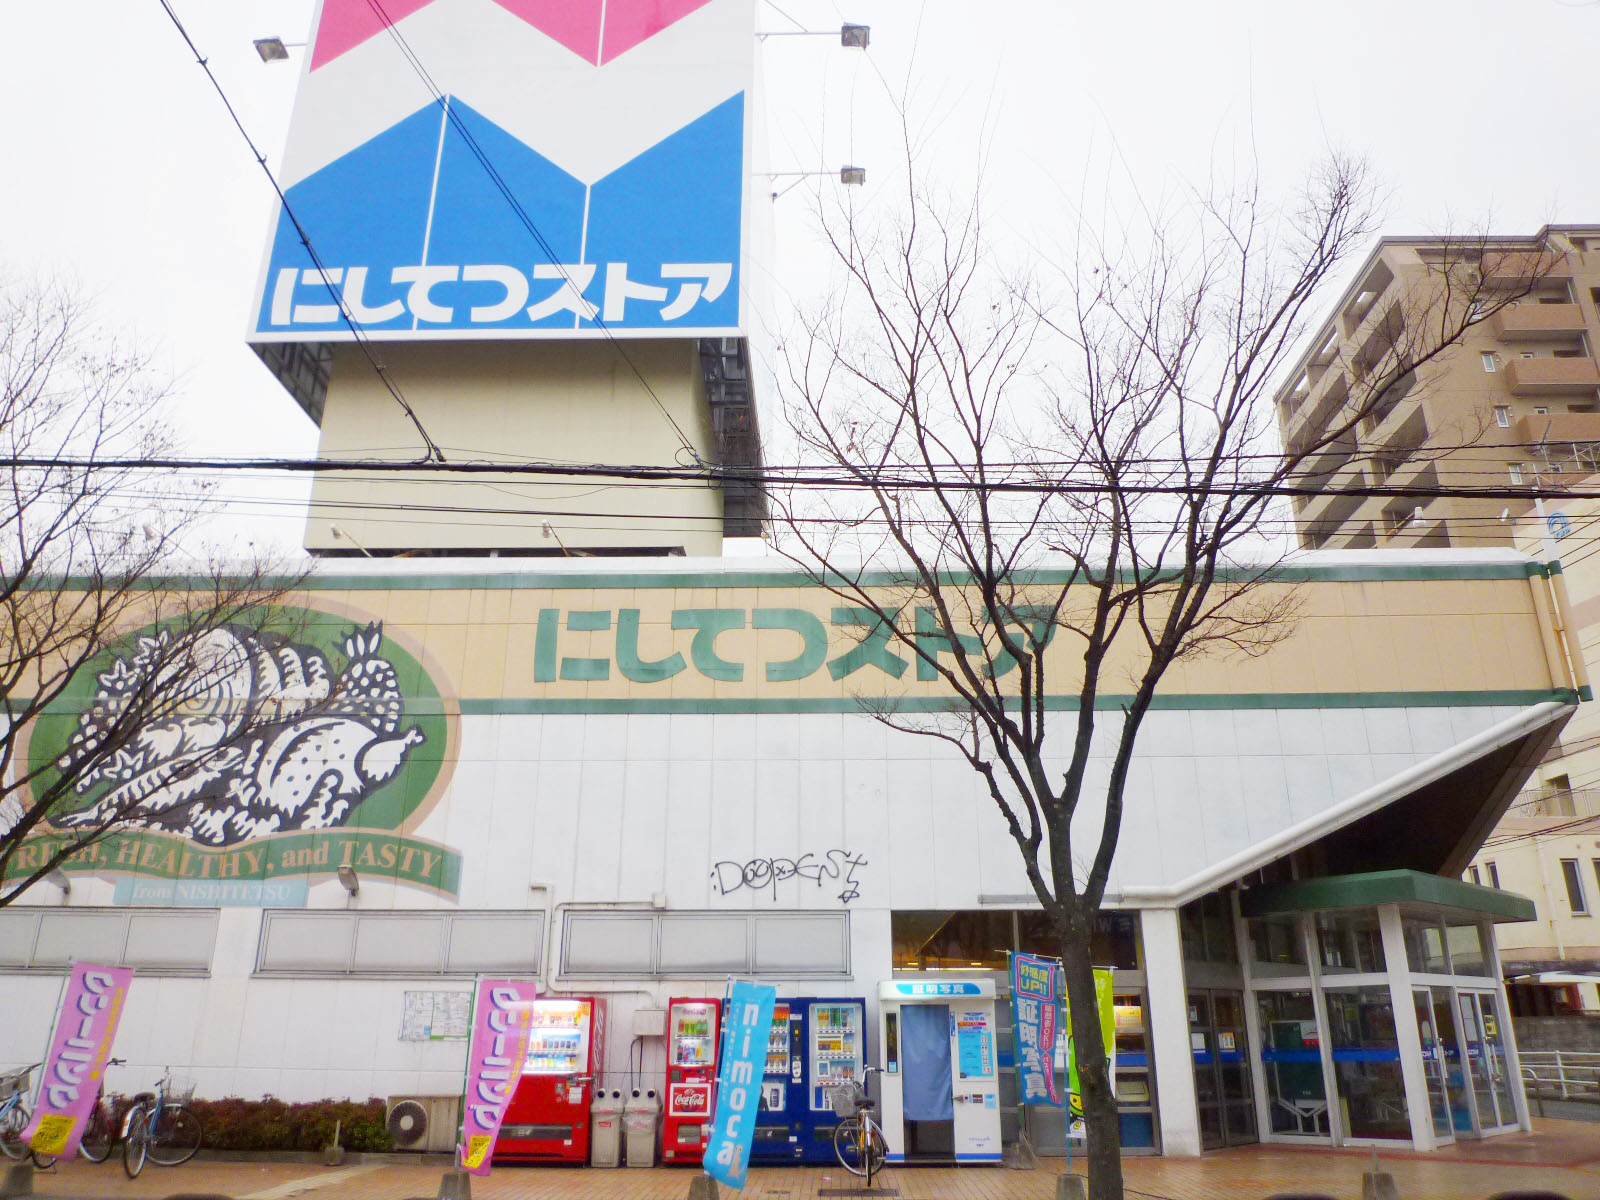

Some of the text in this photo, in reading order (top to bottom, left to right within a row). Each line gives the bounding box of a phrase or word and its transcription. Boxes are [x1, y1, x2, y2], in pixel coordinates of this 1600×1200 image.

[270, 262, 733, 326] にしてつストア
[534, 605, 1059, 683] にしてつストア
[117, 838, 274, 879] HEALTHY,
[281, 843, 329, 867] and
[339, 840, 442, 878] TASTY
[133, 883, 292, 901] from NISHITETSU
[911, 983, 965, 995] 証明写真
[1017, 997, 1048, 1100] 証明写真
[716, 1003, 760, 1167] nimoca
